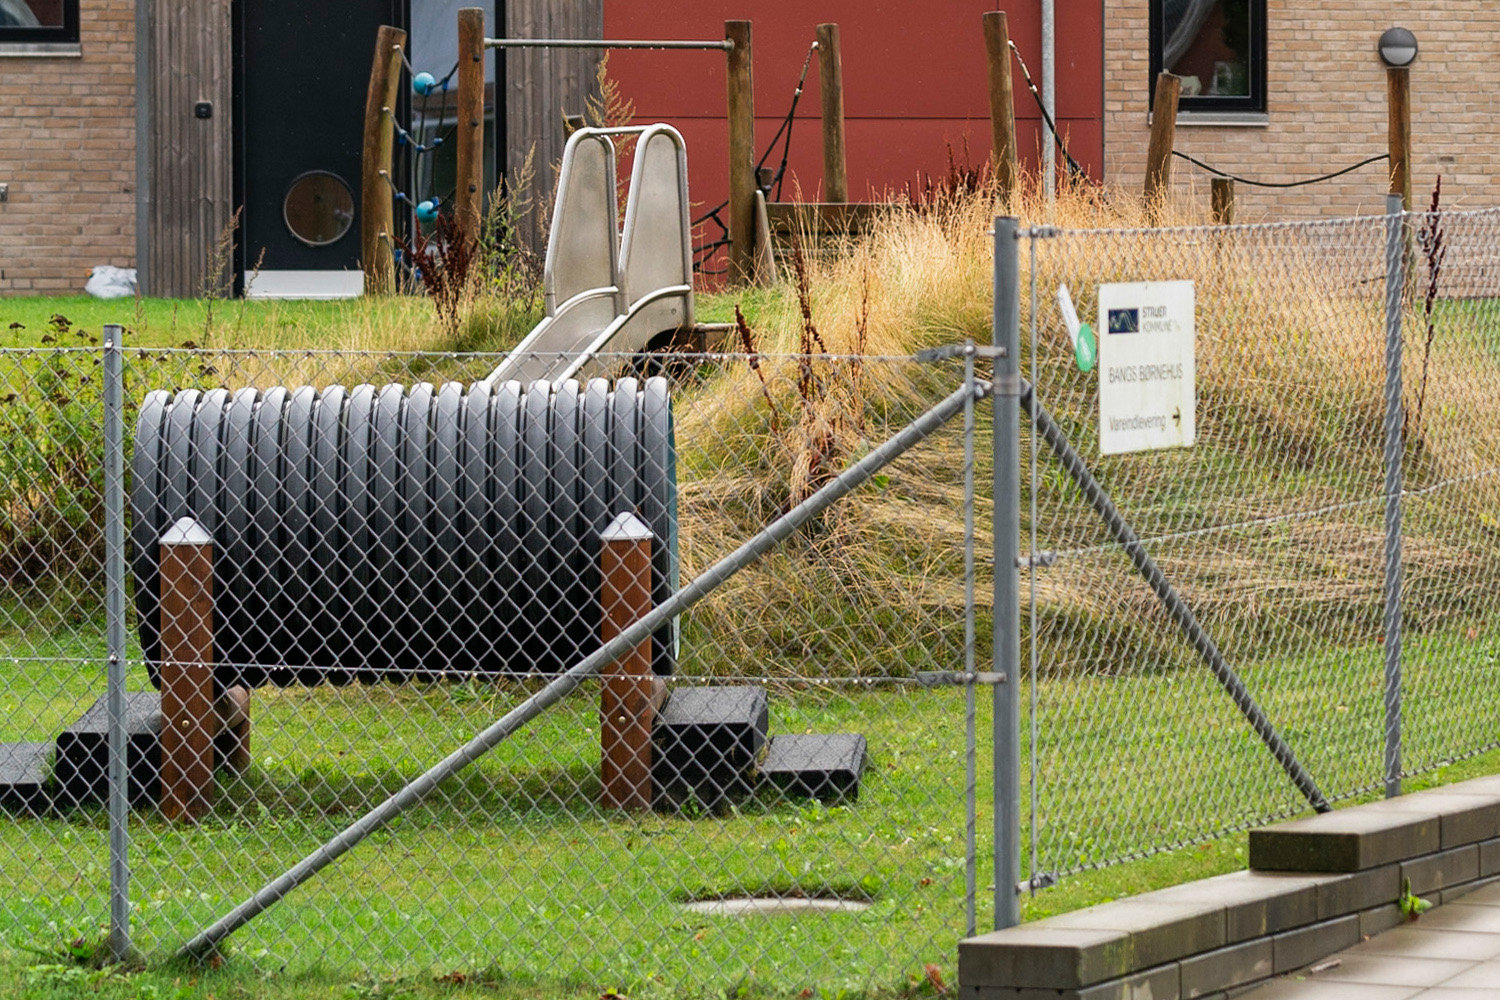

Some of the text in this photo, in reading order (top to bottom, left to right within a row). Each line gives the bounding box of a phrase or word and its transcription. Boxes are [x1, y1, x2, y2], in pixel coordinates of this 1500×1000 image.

[1142, 305, 1167, 318] STRUER
[1142, 319, 1172, 333] KOMMUNE
[1109, 363, 1183, 384] BANGS BØRNEHUS
[1109, 414, 1166, 432] Vareindlevering
